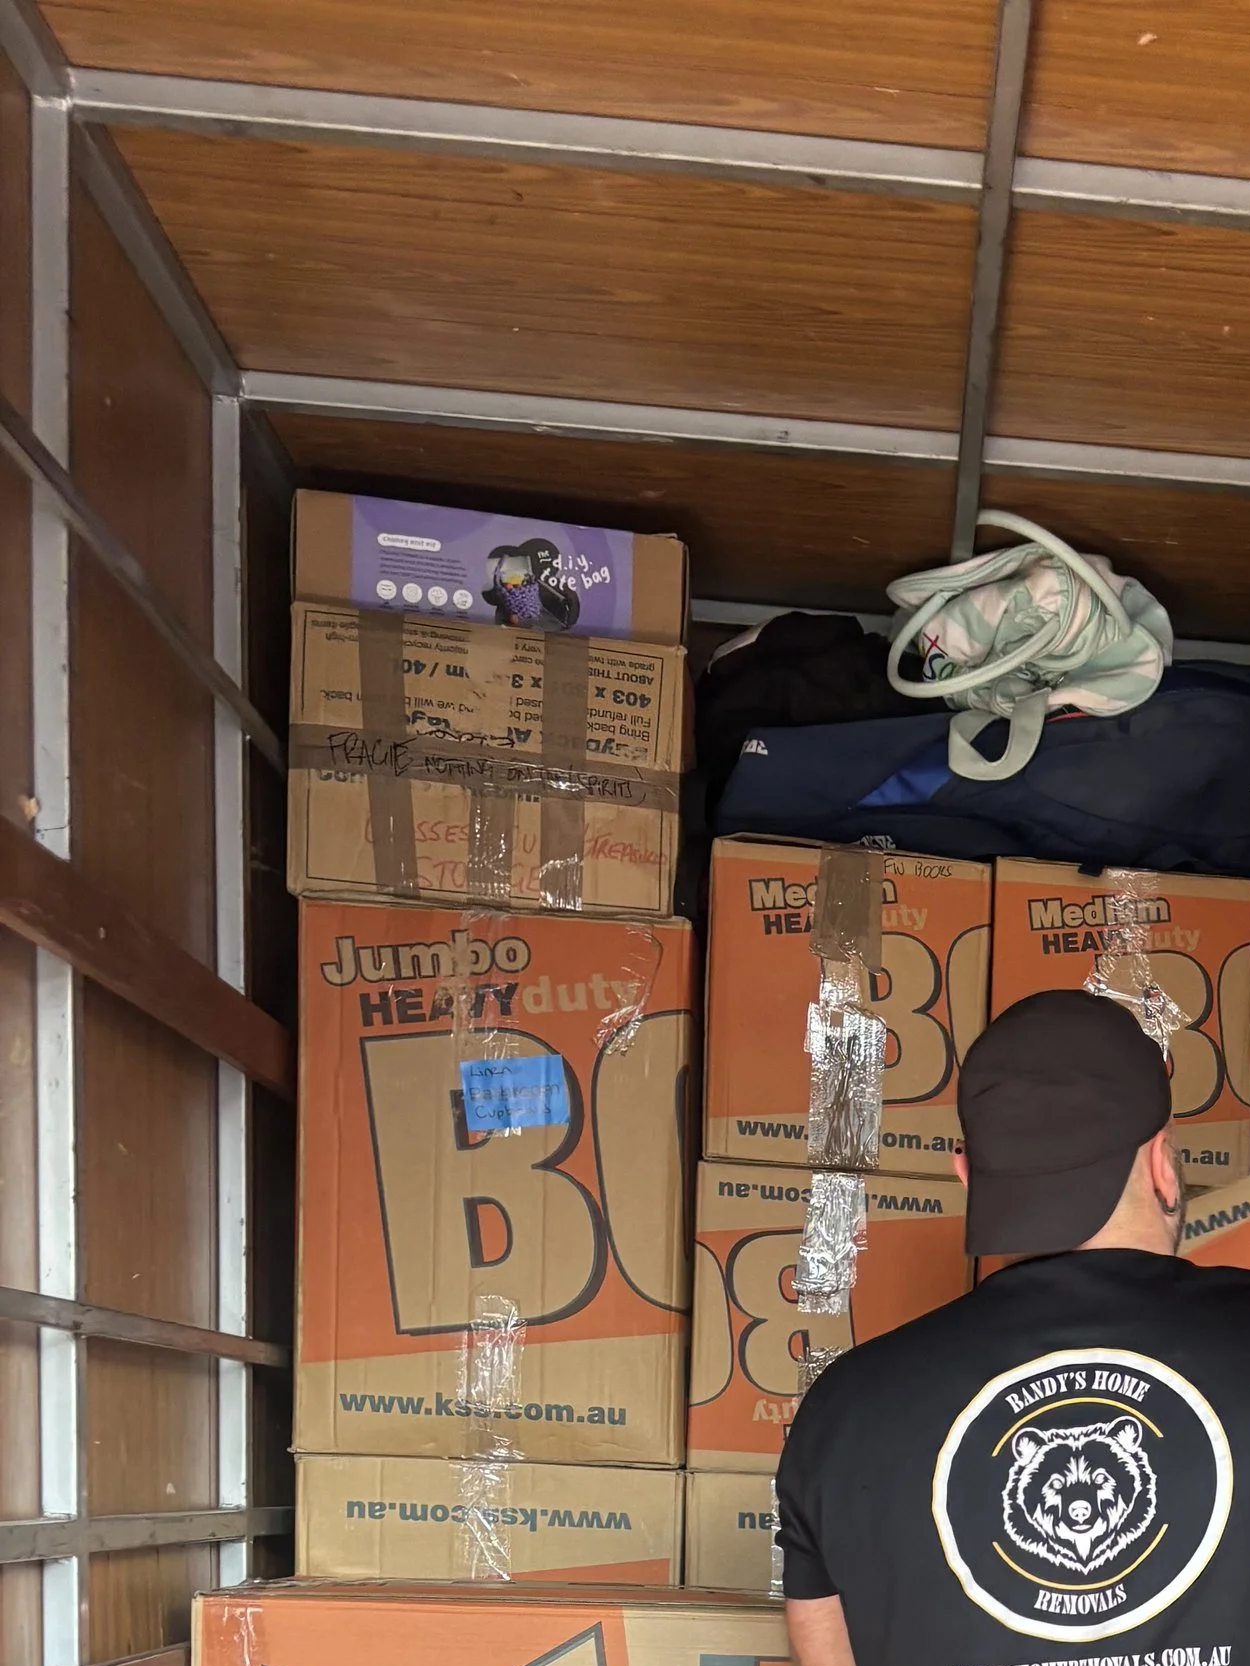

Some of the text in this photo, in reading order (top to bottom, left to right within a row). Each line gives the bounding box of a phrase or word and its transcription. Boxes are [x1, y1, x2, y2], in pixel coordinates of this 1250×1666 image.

[539, 565, 612, 591] tote bag
[614, 671, 655, 686] ABOUT
[611, 689, 652, 708] 403
[619, 725, 650, 742] Bring
[629, 715, 652, 728] Full
[320, 932, 531, 988] Jumbo
[358, 972, 645, 1029] HEAVY duty
[1092, 1370, 1151, 1403] HOME
[1033, 1584, 1128, 1616] REMOVALS
